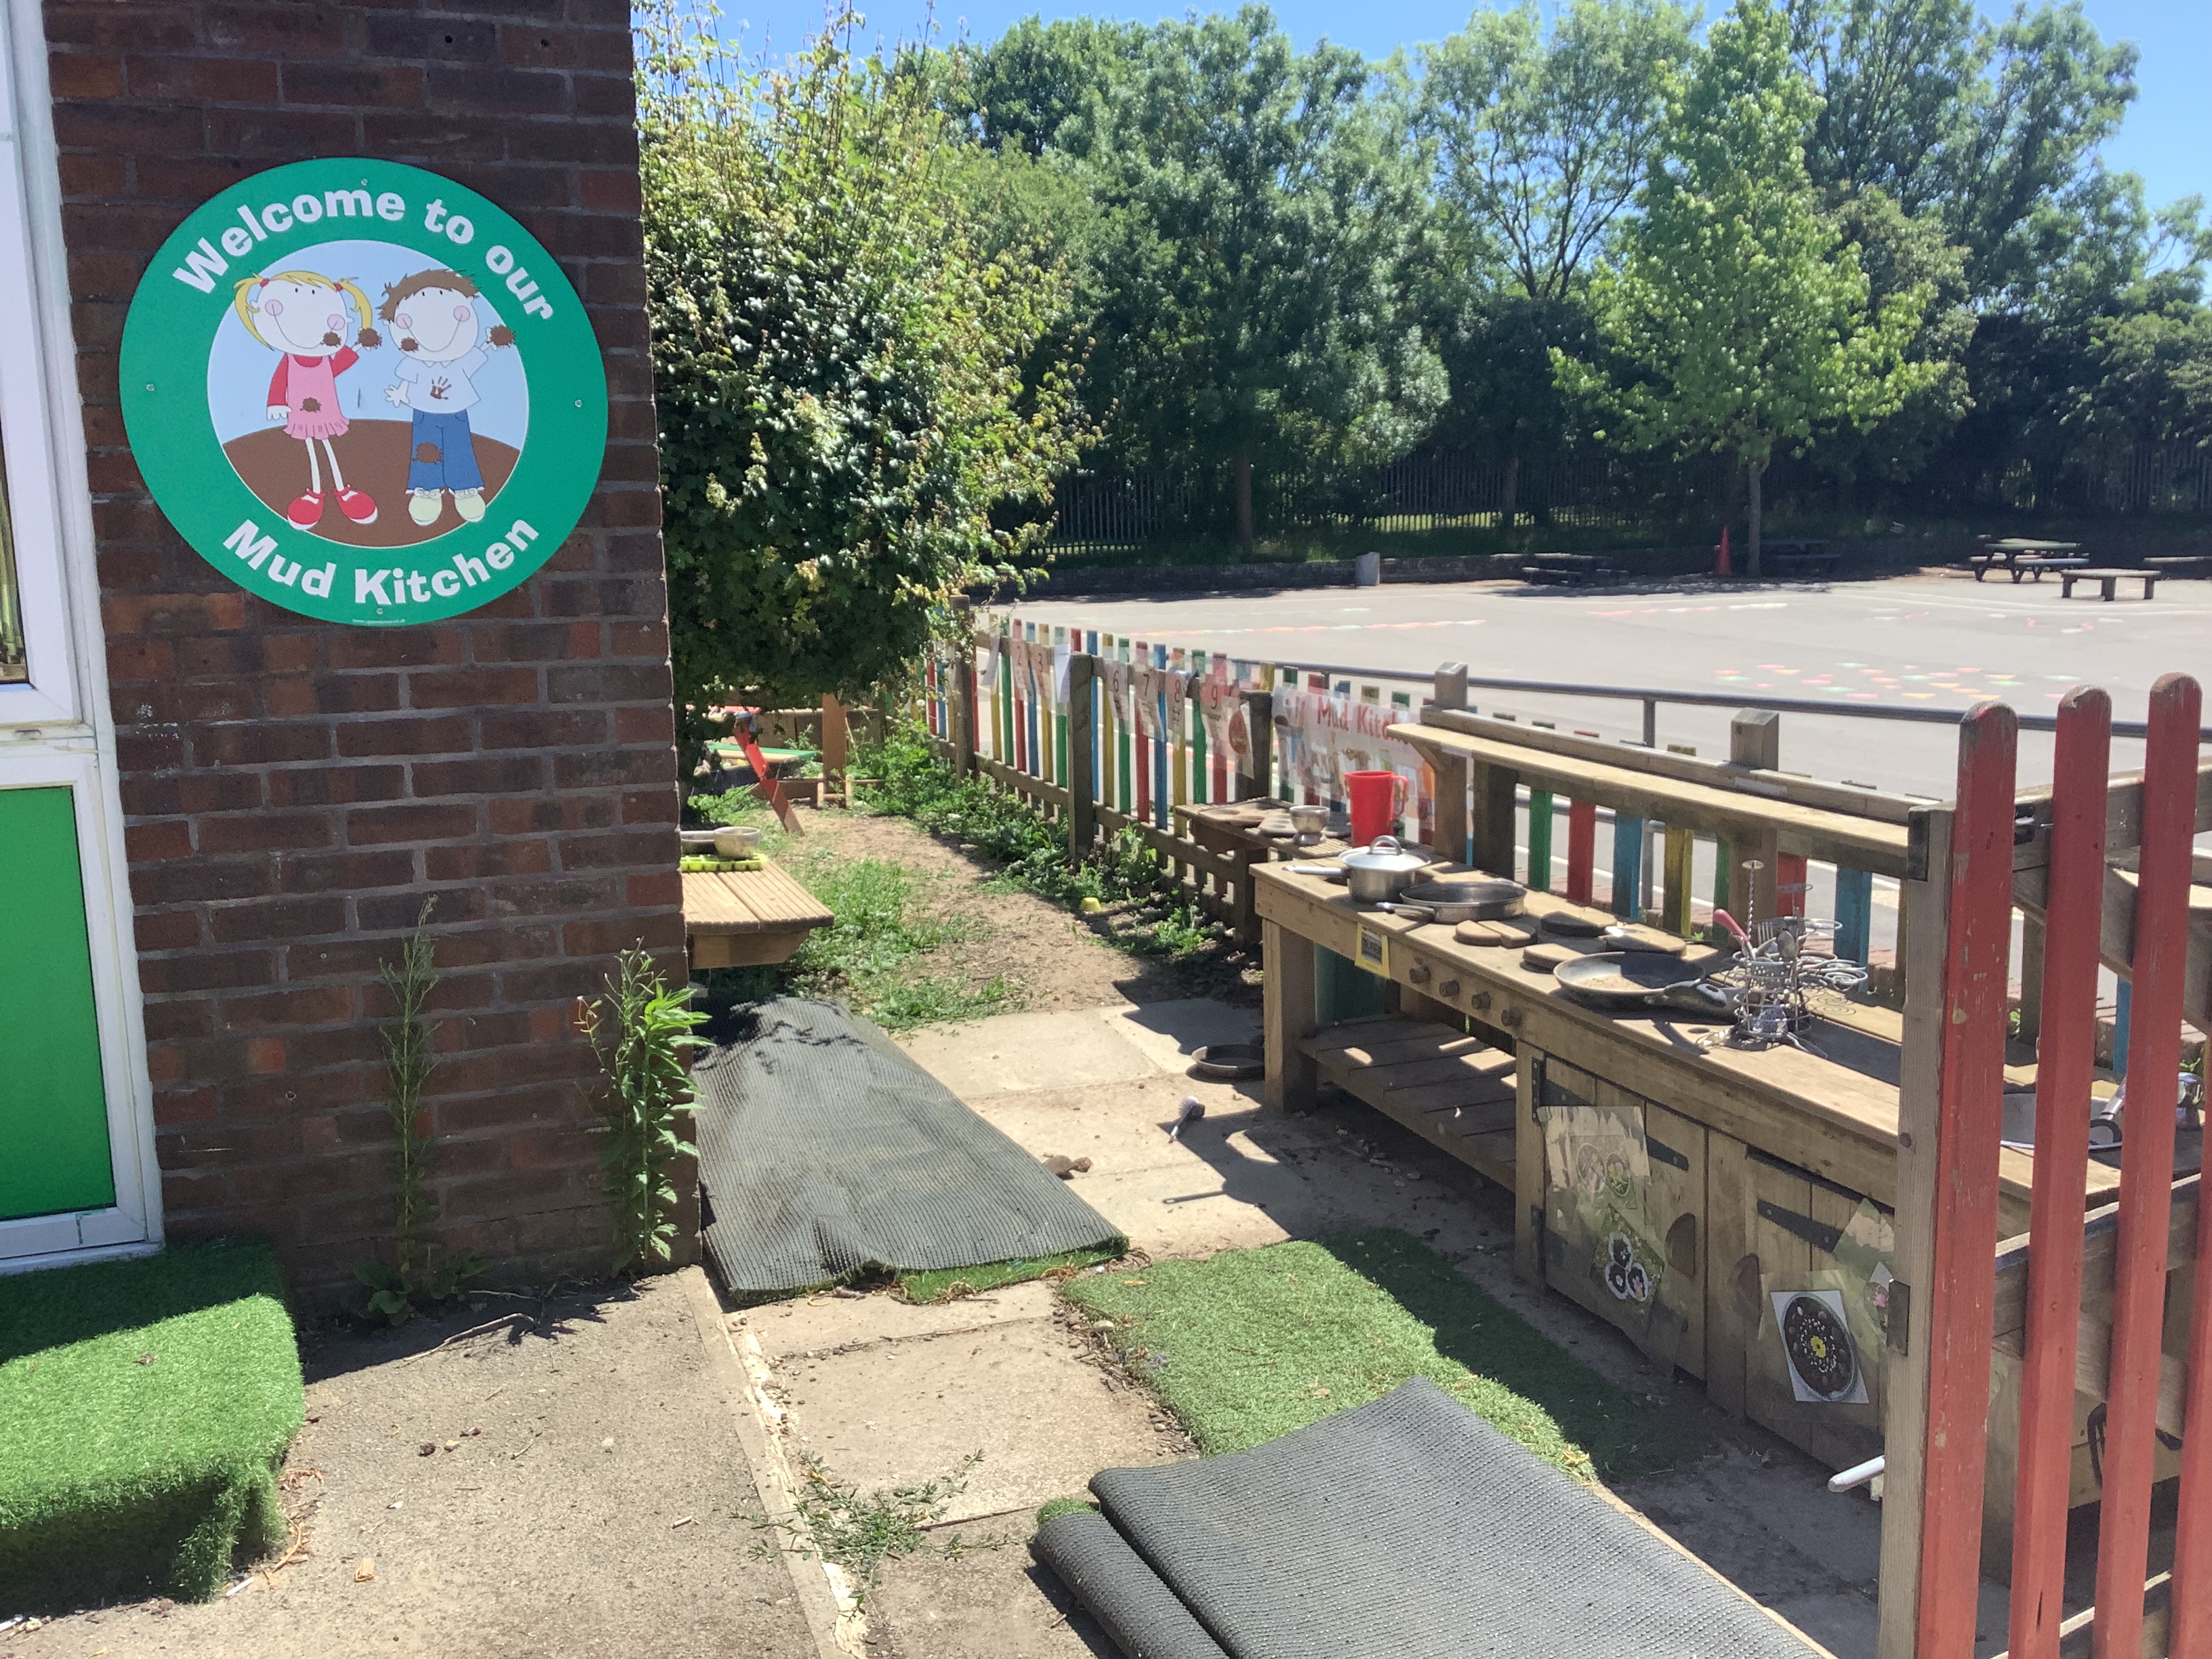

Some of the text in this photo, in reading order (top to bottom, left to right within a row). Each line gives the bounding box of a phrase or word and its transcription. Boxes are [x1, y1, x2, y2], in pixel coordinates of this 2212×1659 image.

[172, 188, 555, 321] Welcome to our
[222, 517, 539, 606] Mud Kitchen
[1038, 652, 1044, 673] 3
[1113, 669, 1120, 693] 6
[1143, 672, 1151, 697] 7
[1174, 678, 1181, 703] 8
[1210, 684, 1218, 710] 9
[1317, 696, 1349, 732] Mud
[1356, 703, 1410, 745] Kitc
